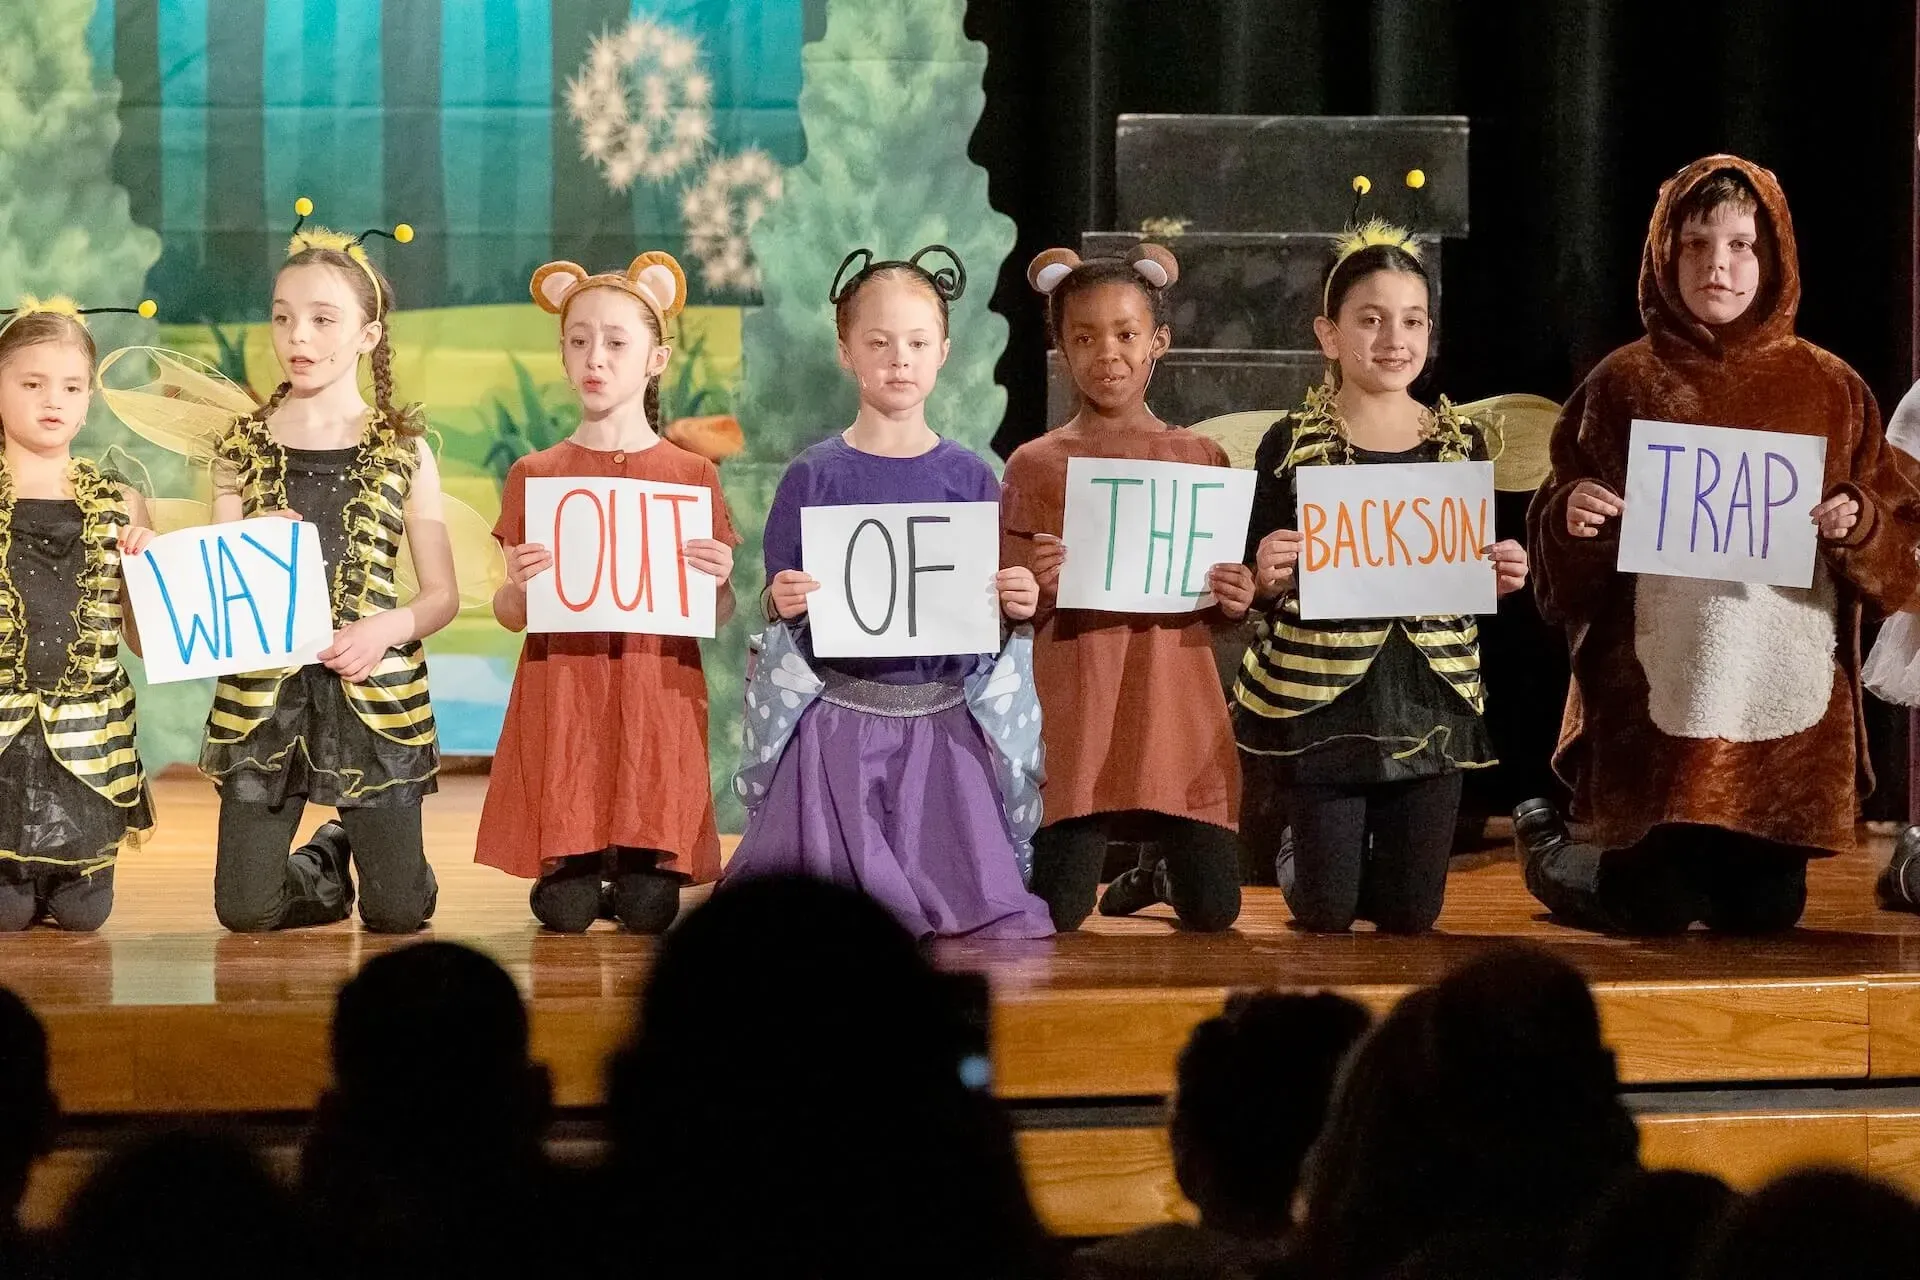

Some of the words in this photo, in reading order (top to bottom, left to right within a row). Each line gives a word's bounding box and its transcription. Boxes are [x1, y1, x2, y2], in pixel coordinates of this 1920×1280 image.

[554, 489, 698, 618] OUT
[1091, 478, 1225, 598] THE
[1303, 497, 1488, 572] BACKSON
[1647, 444, 1799, 560] TRAP
[145, 522, 299, 665] WAY
[844, 516, 955, 638] OF
